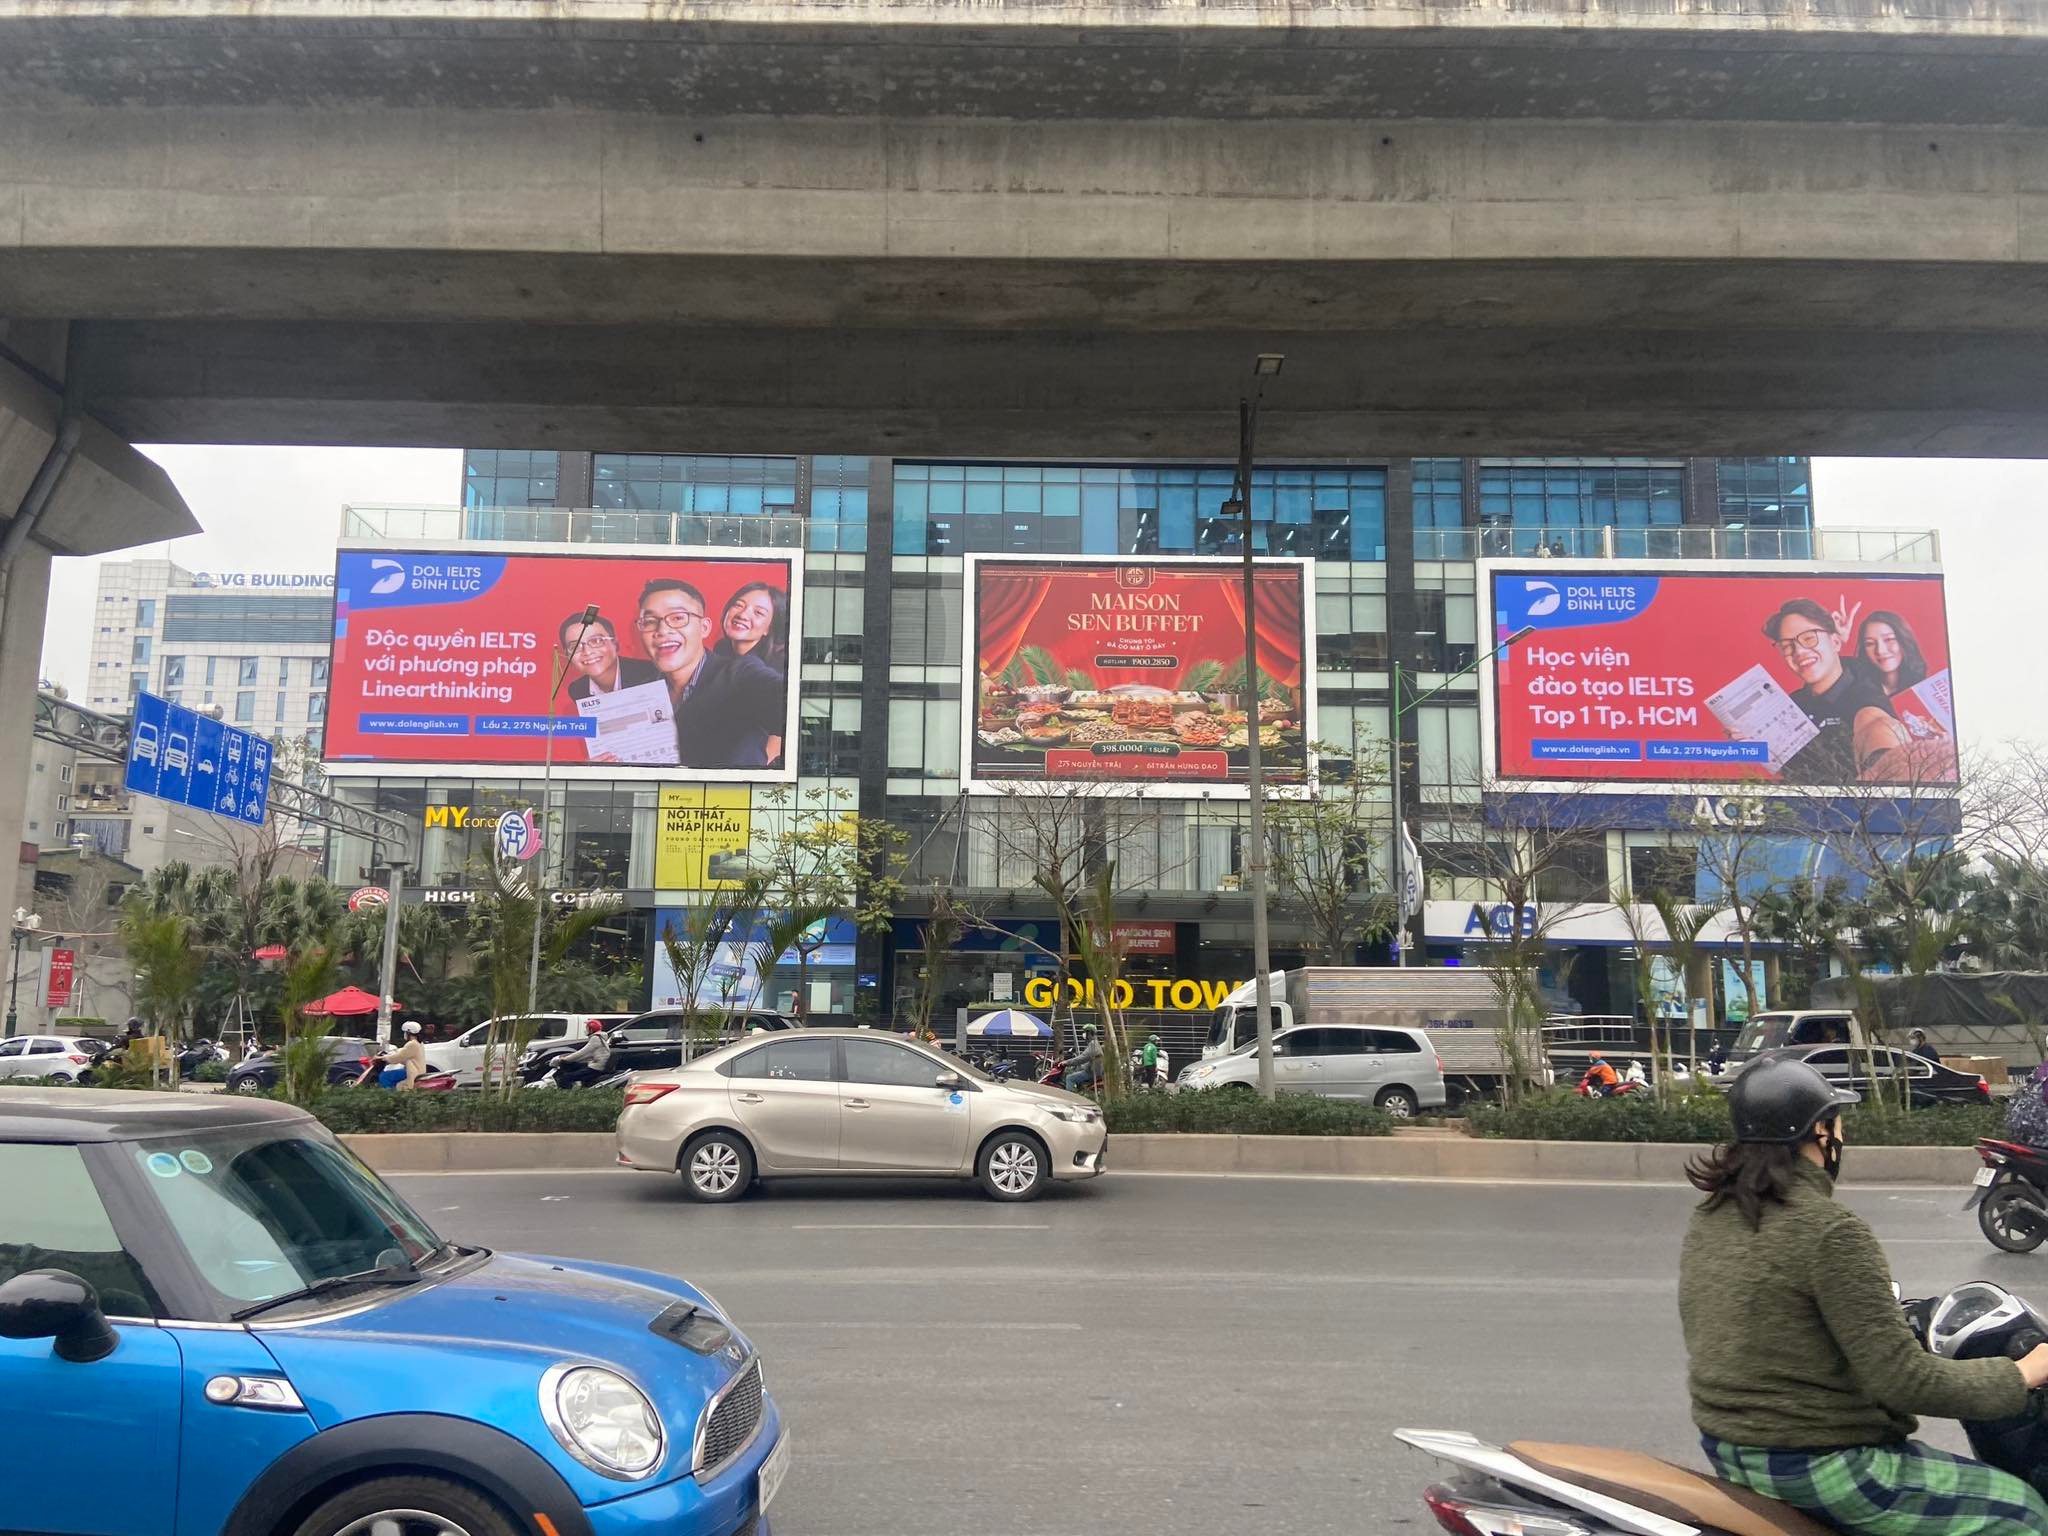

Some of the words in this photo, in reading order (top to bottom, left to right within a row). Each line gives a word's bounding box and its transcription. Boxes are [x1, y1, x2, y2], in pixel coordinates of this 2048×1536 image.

[221, 573, 246, 586] VG
[251, 574, 336, 587] BUILDING
[413, 566, 442, 577] DOL
[447, 566, 481, 578] IELTS
[412, 577, 447, 590] ĐÌNH
[452, 579, 480, 592] LỰC
[1567, 587, 1597, 598] DOL
[1601, 587, 1636, 598] IELTS
[1091, 593, 1182, 611] MAISON
[1567, 597, 1603, 611] ĐÌNH
[1608, 599, 1636, 613] LỰC
[1068, 614, 1112, 631] SEN
[1116, 614, 1204, 632] BUFFET
[366, 629, 409, 651] Độc
[413, 628, 475, 651] quyền
[480, 632, 537, 649] IELTS
[364, 656, 394, 672] với
[399, 657, 478, 677] phương
[483, 658, 536, 677] pháp
[1132, 658, 1171, 666] 1900.2850
[1527, 647, 1576, 671] Học
[1580, 647, 1630, 671] viện
[362, 680, 513, 703] Linearthinking
[1528, 675, 1577, 696] đào
[1583, 678, 1624, 701] tạo
[1629, 677, 1695, 696] IELTS
[581, 698, 600, 708] IELTS
[369, 720, 459, 730] www.dolenglish.vn
[1529, 705, 1575, 729] Top
[1579, 706, 1590, 725] 1
[1594, 706, 1633, 729] Tp.
[1639, 706, 1697, 726] HCM
[483, 721, 501, 730] Lầu
[502, 721, 511, 731] 2,
[513, 721, 531, 730] 275
[569, 721, 587, 731] Trãi
[1102, 744, 1143, 753] 398.000đ
[1541, 744, 1630, 755] www.dolenglish.vn
[1653, 745, 1671, 755] Lầu
[1673, 747, 1682, 757] 2,
[1685, 746, 1702, 756] 275
[1703, 745, 1739, 758] Nguyễn
[1741, 747, 1760, 757] Trãi
[1057, 760, 1070, 768] 275
[667, 806, 690, 822] NỘI
[694, 804, 725, 820] THẤT
[1690, 797, 1767, 826] ACB
[667, 820, 701, 834] NHẬP
[707, 817, 740, 832] KHẨU
[1464, 904, 1538, 936] ACB
[1116, 928, 1152, 937] MAISON
[1153, 928, 1172, 938] SEN
[1025, 977, 1134, 1010] GOLD
[1147, 978, 1246, 1011] TOW
